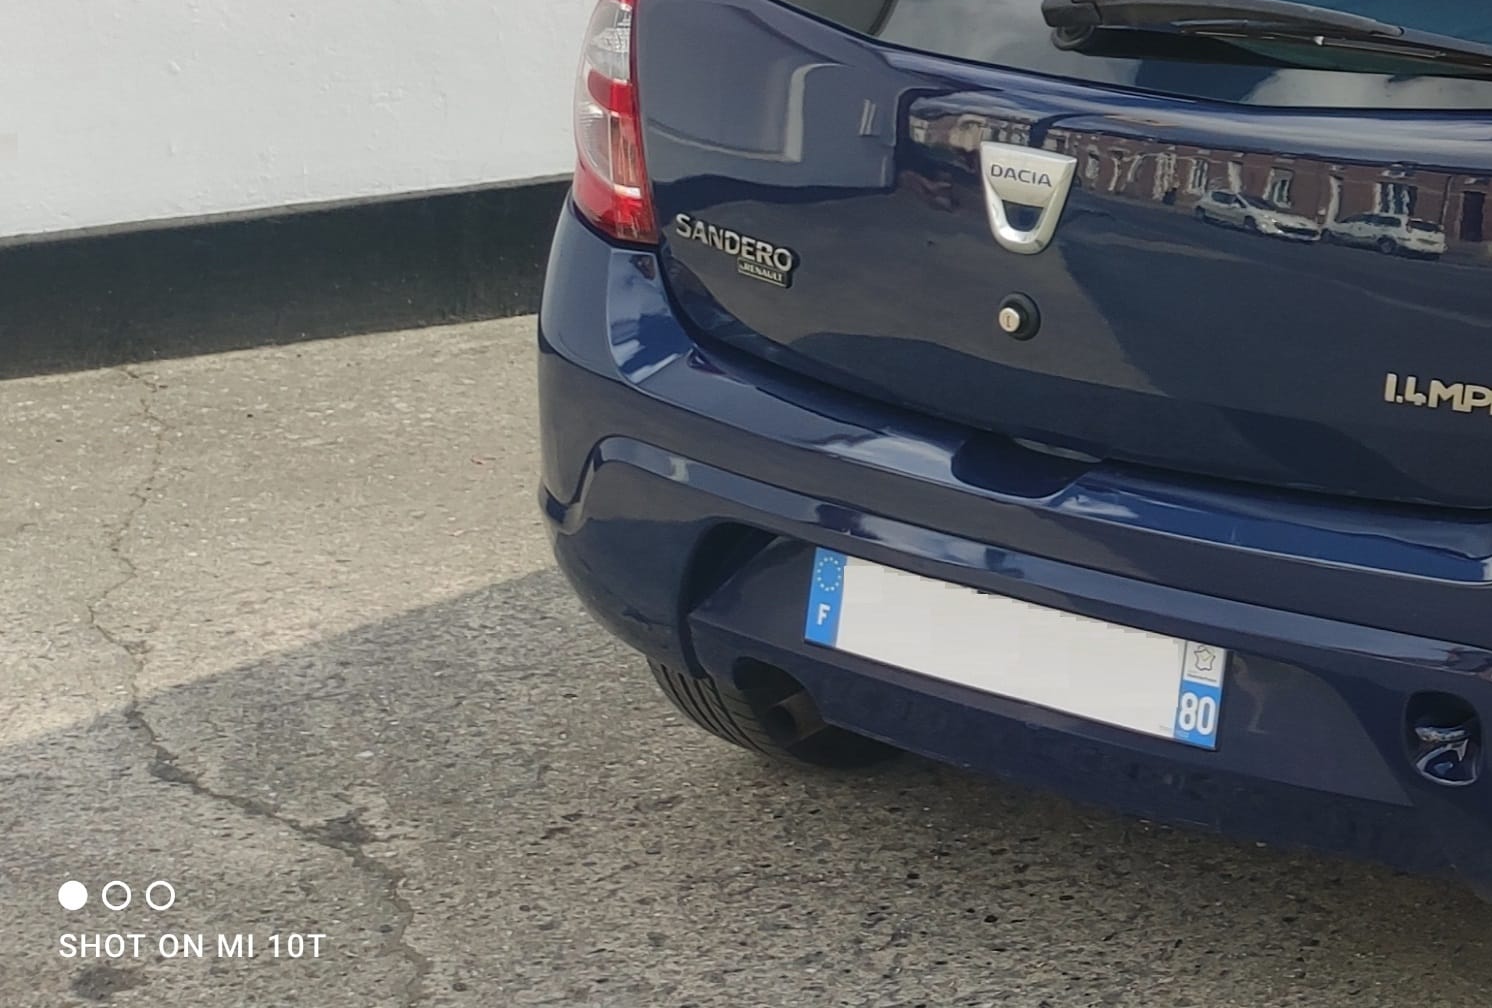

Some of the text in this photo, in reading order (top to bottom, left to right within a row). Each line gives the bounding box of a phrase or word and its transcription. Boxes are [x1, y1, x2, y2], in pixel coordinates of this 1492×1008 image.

[990, 163, 1052, 188] DACIA
[675, 212, 793, 272] SANDERO
[816, 603, 831, 626] F
[1178, 690, 1217, 736] 80
